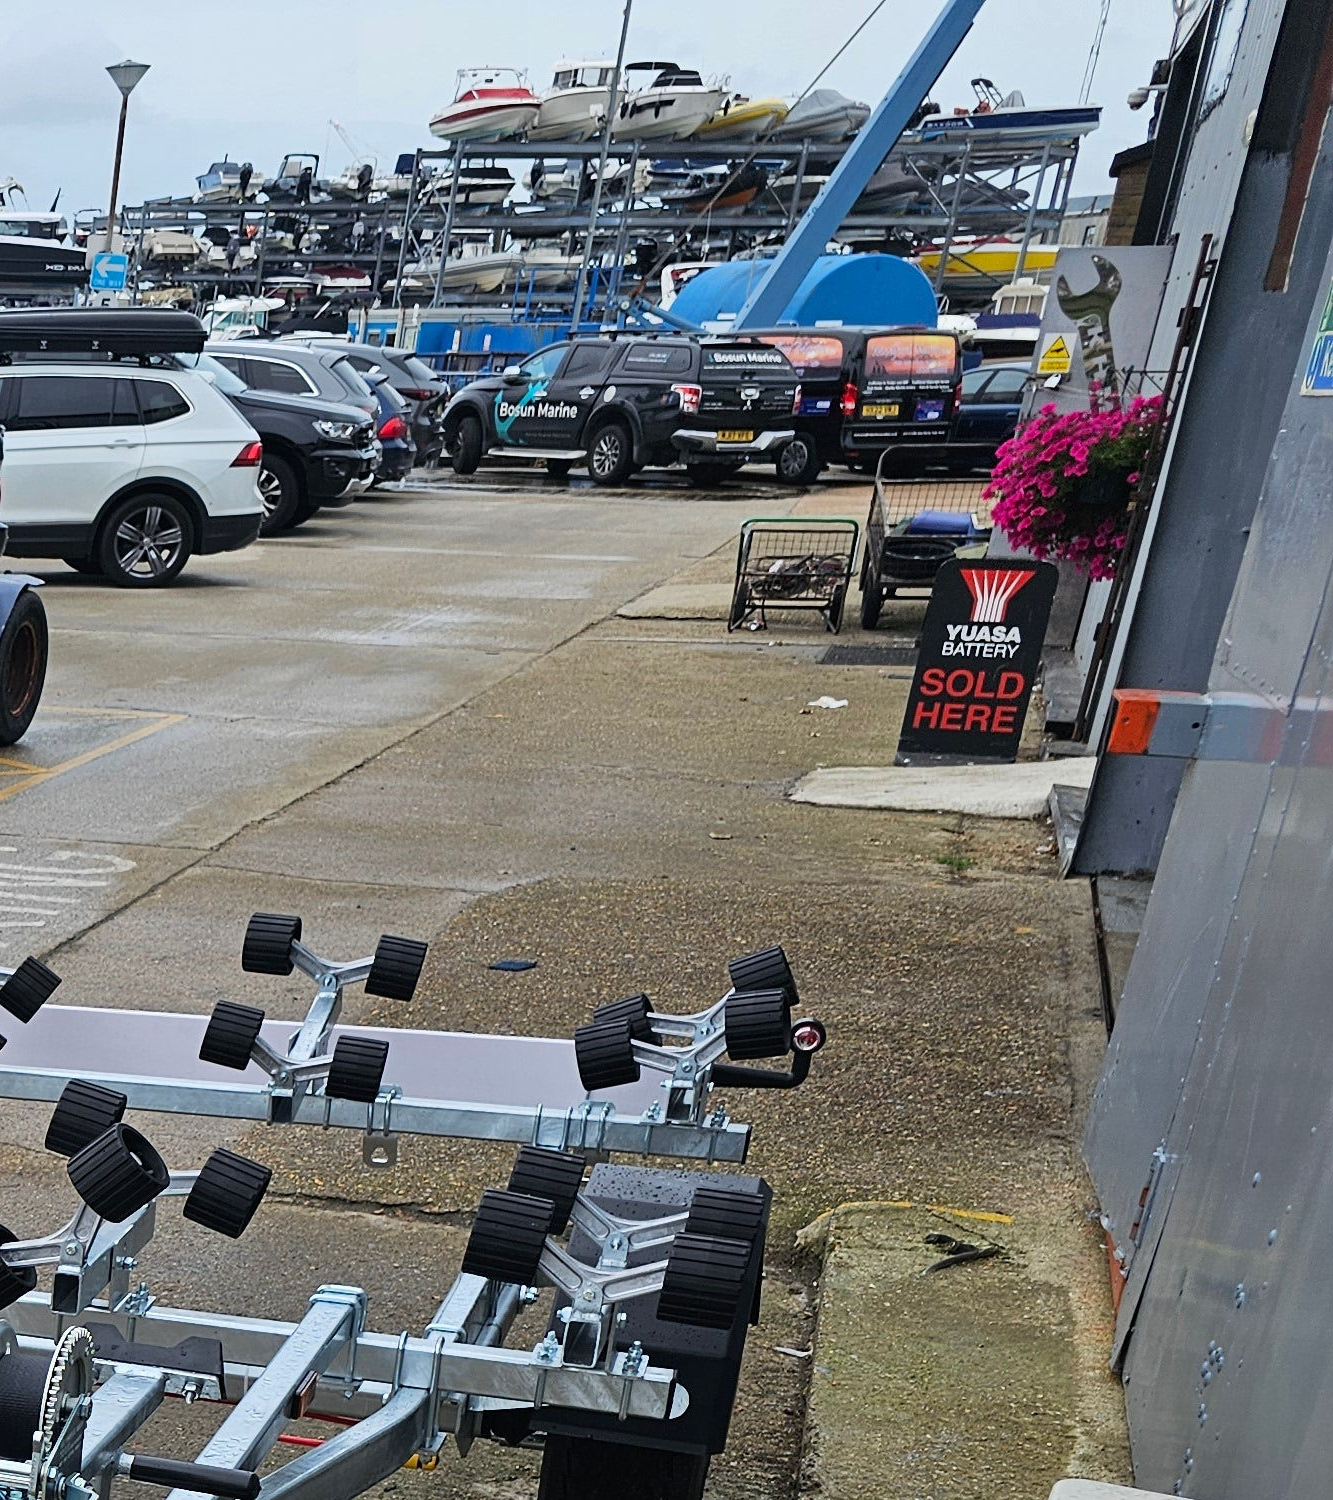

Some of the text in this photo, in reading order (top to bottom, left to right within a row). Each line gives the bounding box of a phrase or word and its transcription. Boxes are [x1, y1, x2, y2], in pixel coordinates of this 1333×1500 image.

[713, 353, 782, 363] Bosun Marine
[499, 401, 578, 419] Bosun Marine
[946, 624, 1021, 643] YUASA
[941, 641, 1021, 659] BATTERY
[919, 667, 1026, 700] SOLD
[912, 701, 1018, 733] HERE
